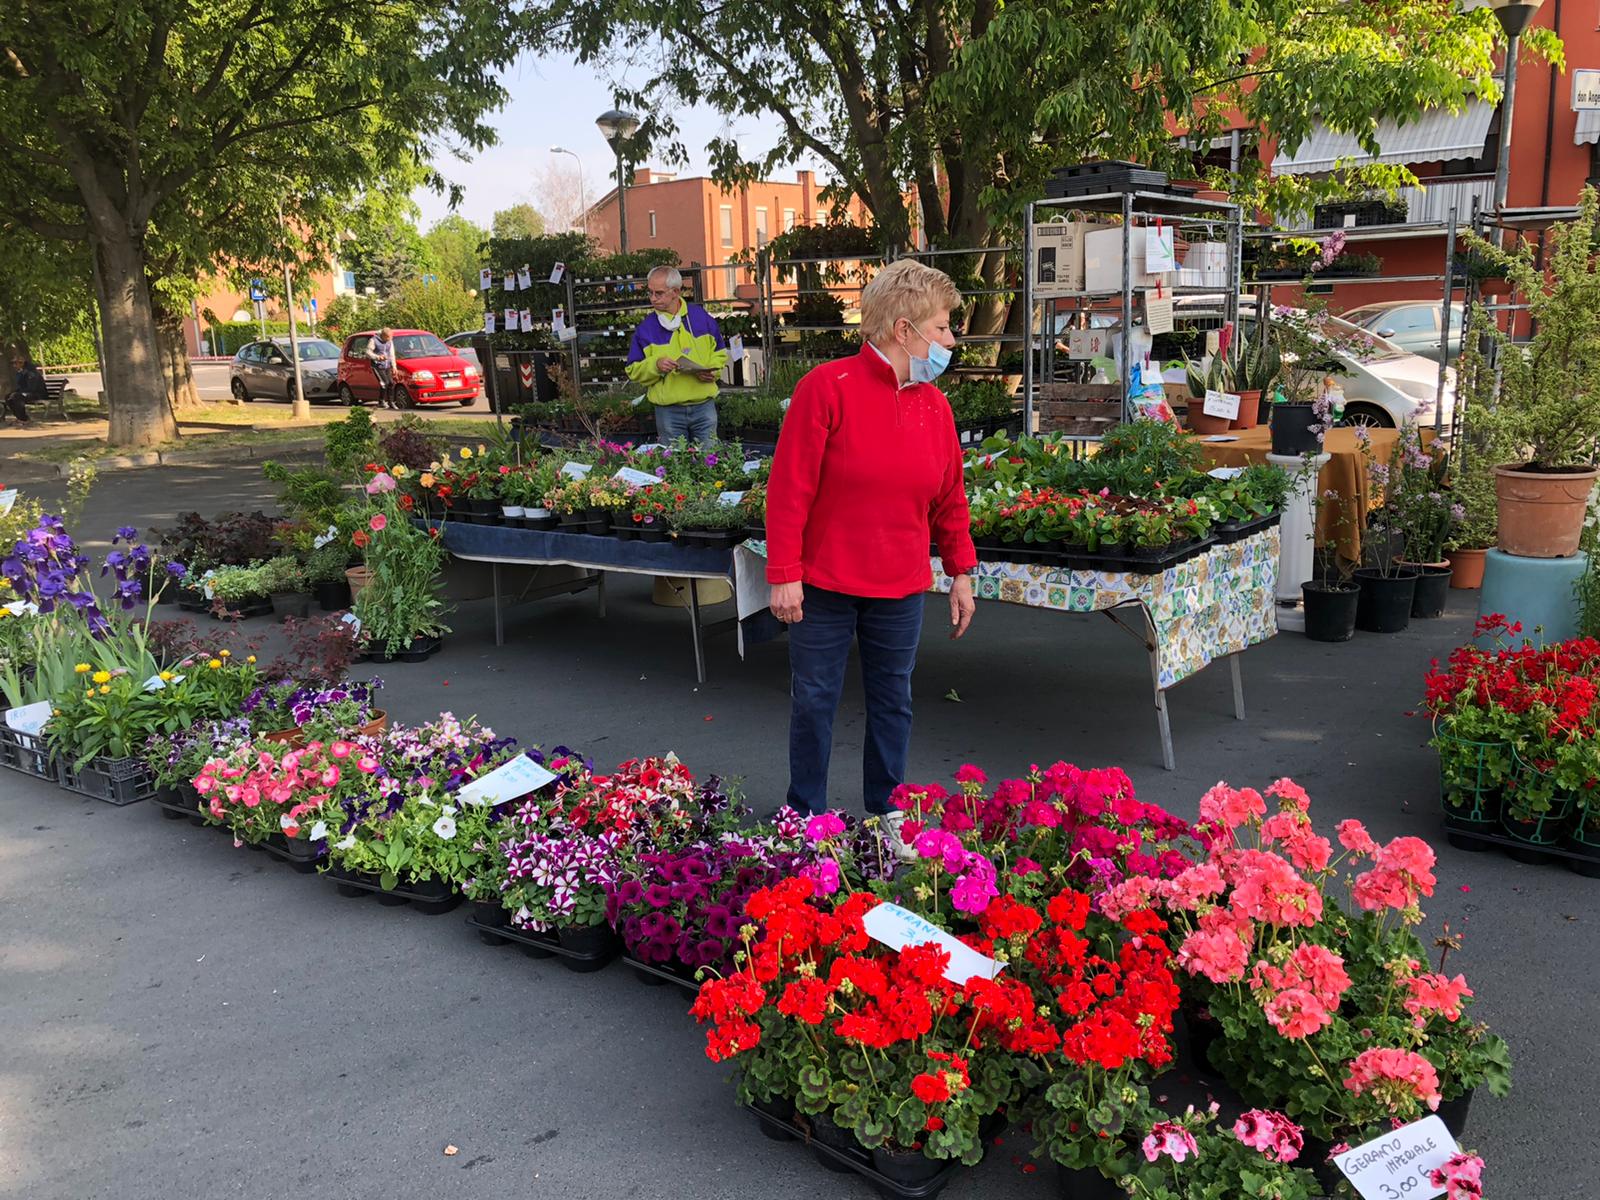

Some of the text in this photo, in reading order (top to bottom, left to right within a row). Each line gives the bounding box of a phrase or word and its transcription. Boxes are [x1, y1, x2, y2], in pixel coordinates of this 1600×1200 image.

[1577, 89, 1587, 103] don
[1344, 1137, 1402, 1175] GERANIO
[1385, 1136, 1438, 1175] IMPERIALE
[1379, 1176, 1418, 1200] 3,00
